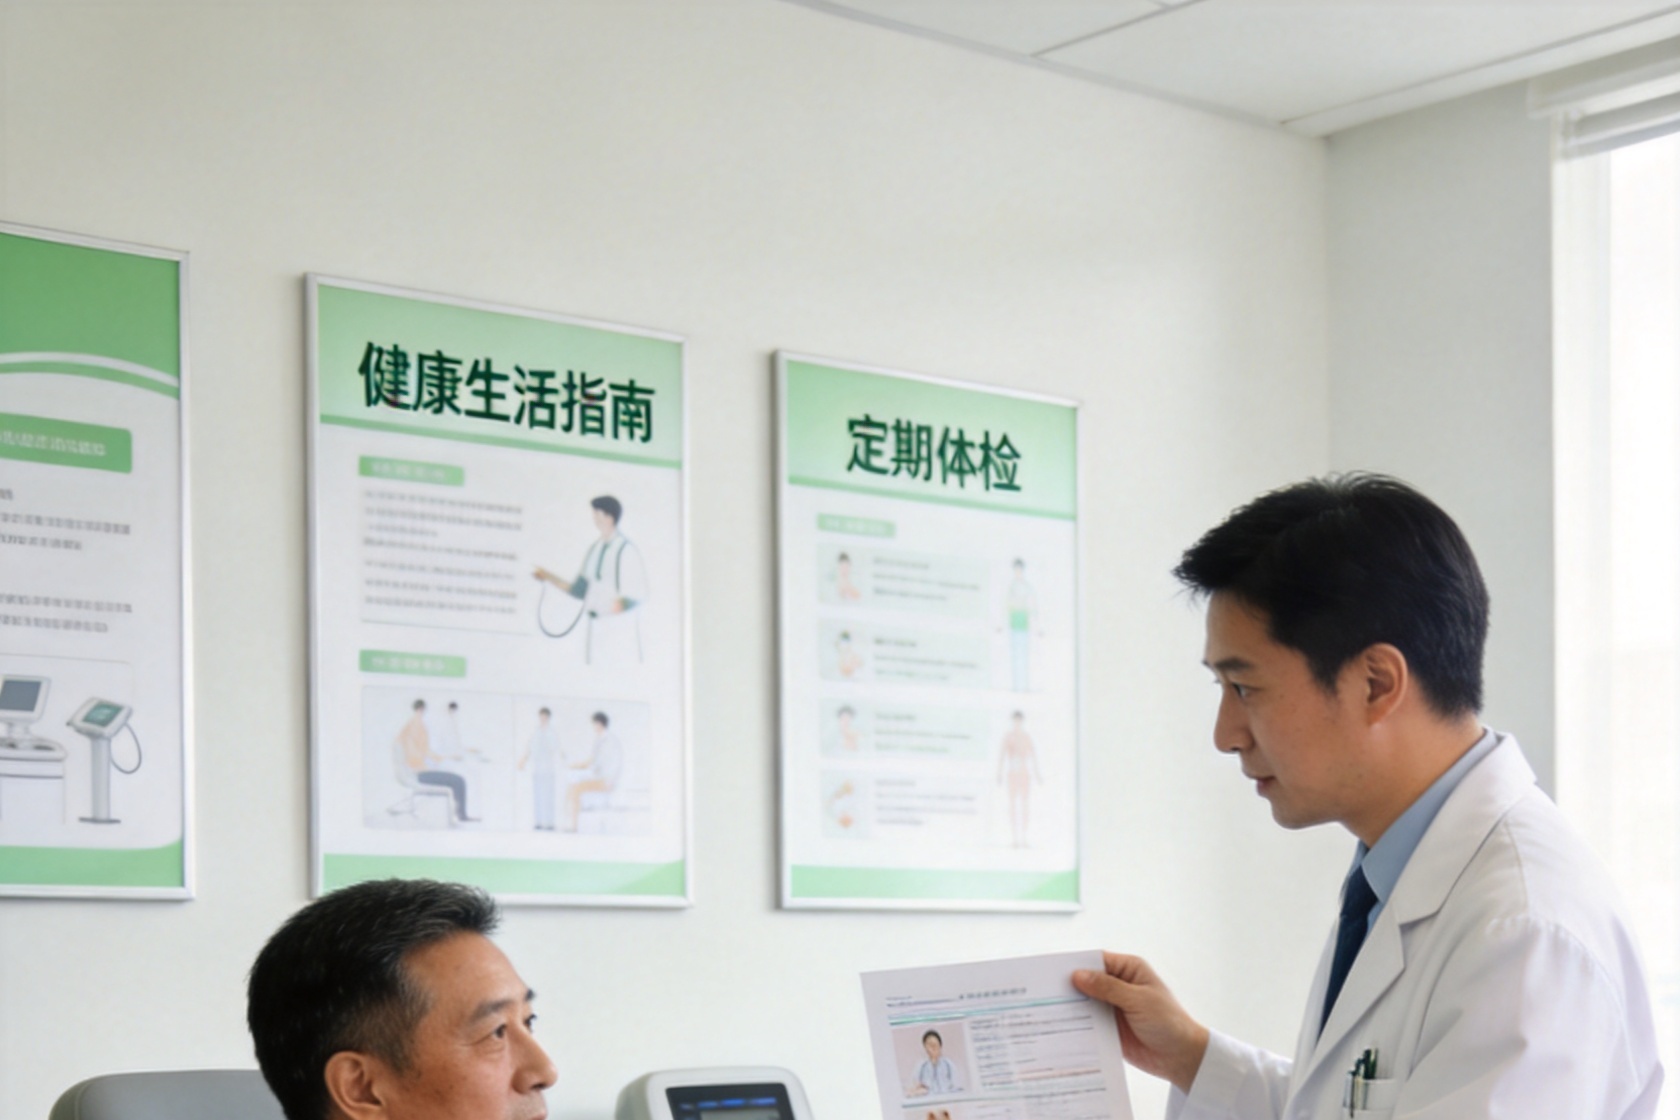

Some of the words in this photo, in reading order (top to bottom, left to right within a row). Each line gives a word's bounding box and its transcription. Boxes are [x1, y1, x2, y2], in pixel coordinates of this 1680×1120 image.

[358, 342, 654, 443] 健康生活指南
[846, 414, 1022, 491] 定期体检
